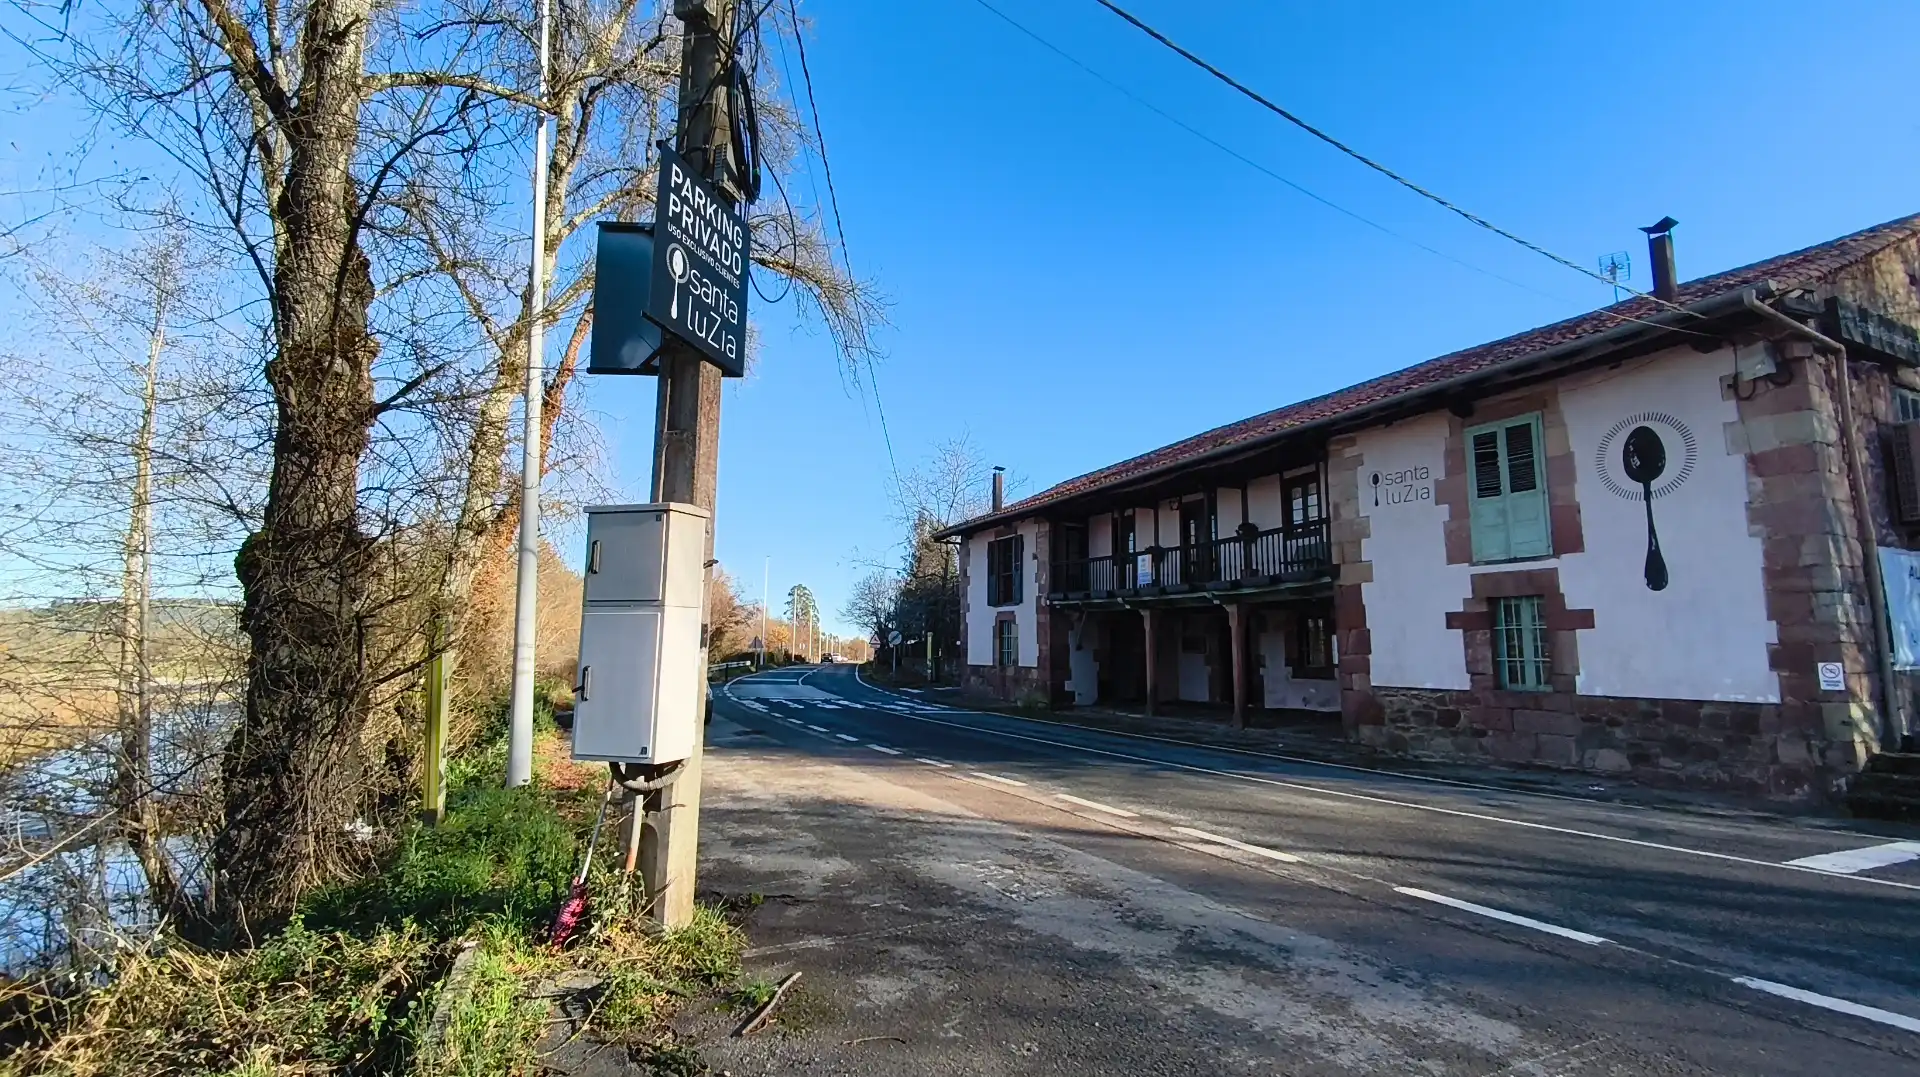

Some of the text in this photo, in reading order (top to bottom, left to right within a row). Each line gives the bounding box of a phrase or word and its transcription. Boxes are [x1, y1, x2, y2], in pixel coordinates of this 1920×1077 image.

[668, 192, 741, 275] PRIVADO
[671, 163, 742, 249] PARKING
[667, 221, 740, 289] USO EXCLUSIVO CLIENTES
[689, 269, 738, 325] santa
[1385, 465, 1429, 486] santa
